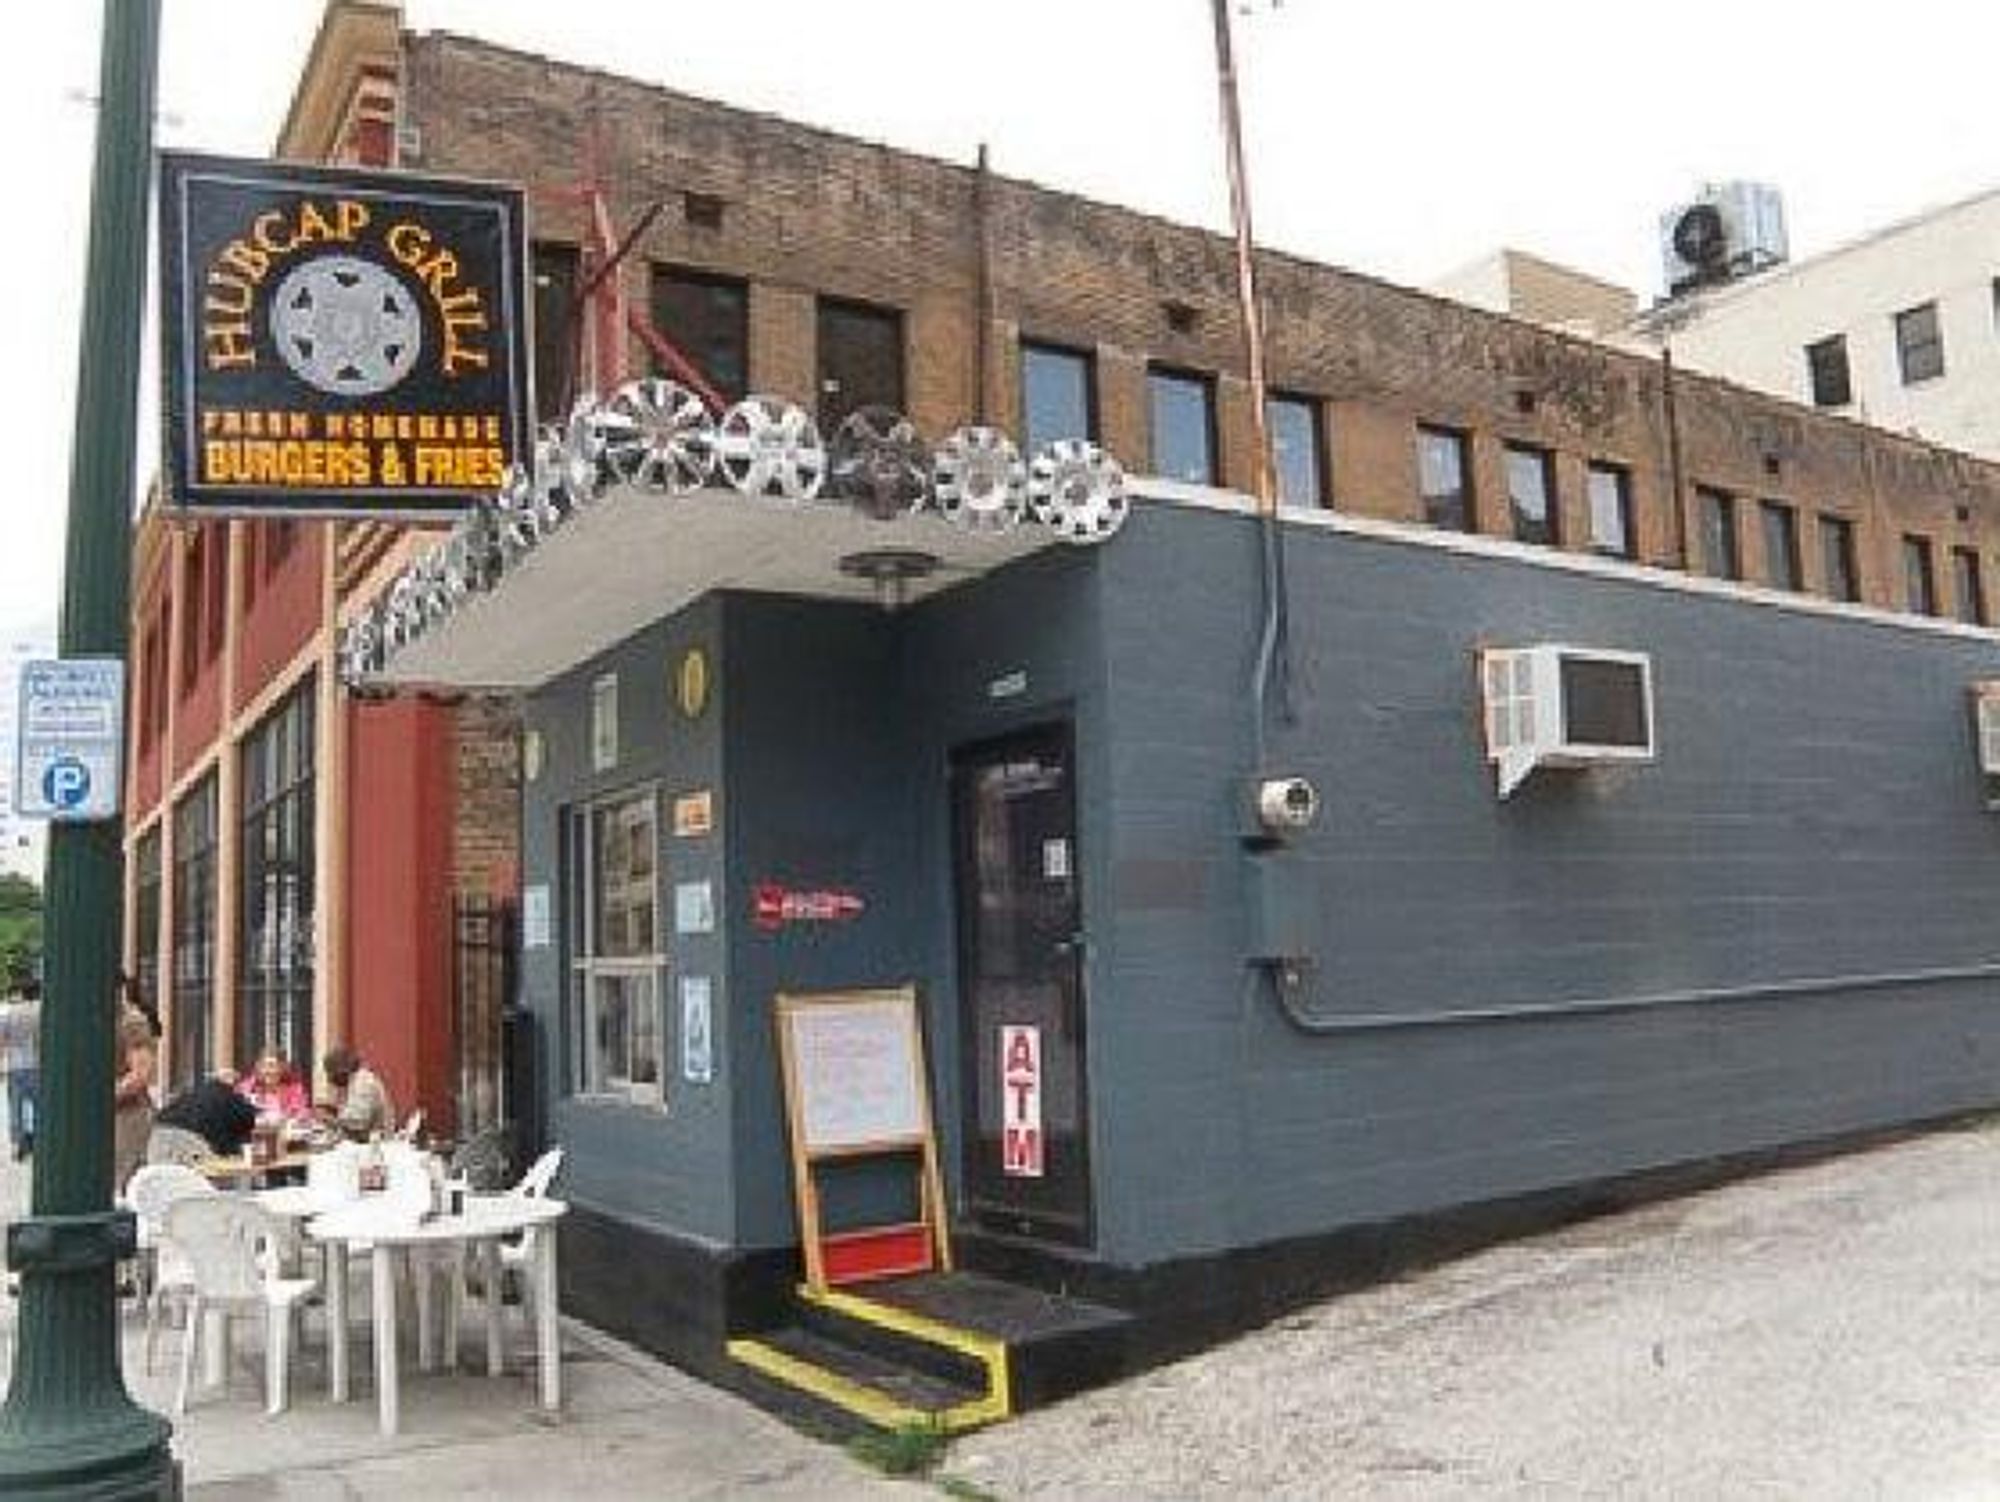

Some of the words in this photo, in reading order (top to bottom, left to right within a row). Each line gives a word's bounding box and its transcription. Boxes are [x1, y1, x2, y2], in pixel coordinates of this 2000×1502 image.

[204, 201, 372, 371] HUBCAP
[386, 223, 489, 375] GRILL
[206, 440, 371, 485] BURGERS
[381, 441, 407, 485] &
[415, 447, 503, 486] FRIES
[54, 766, 81, 806] P
[1007, 1033, 1037, 1168] ATM
